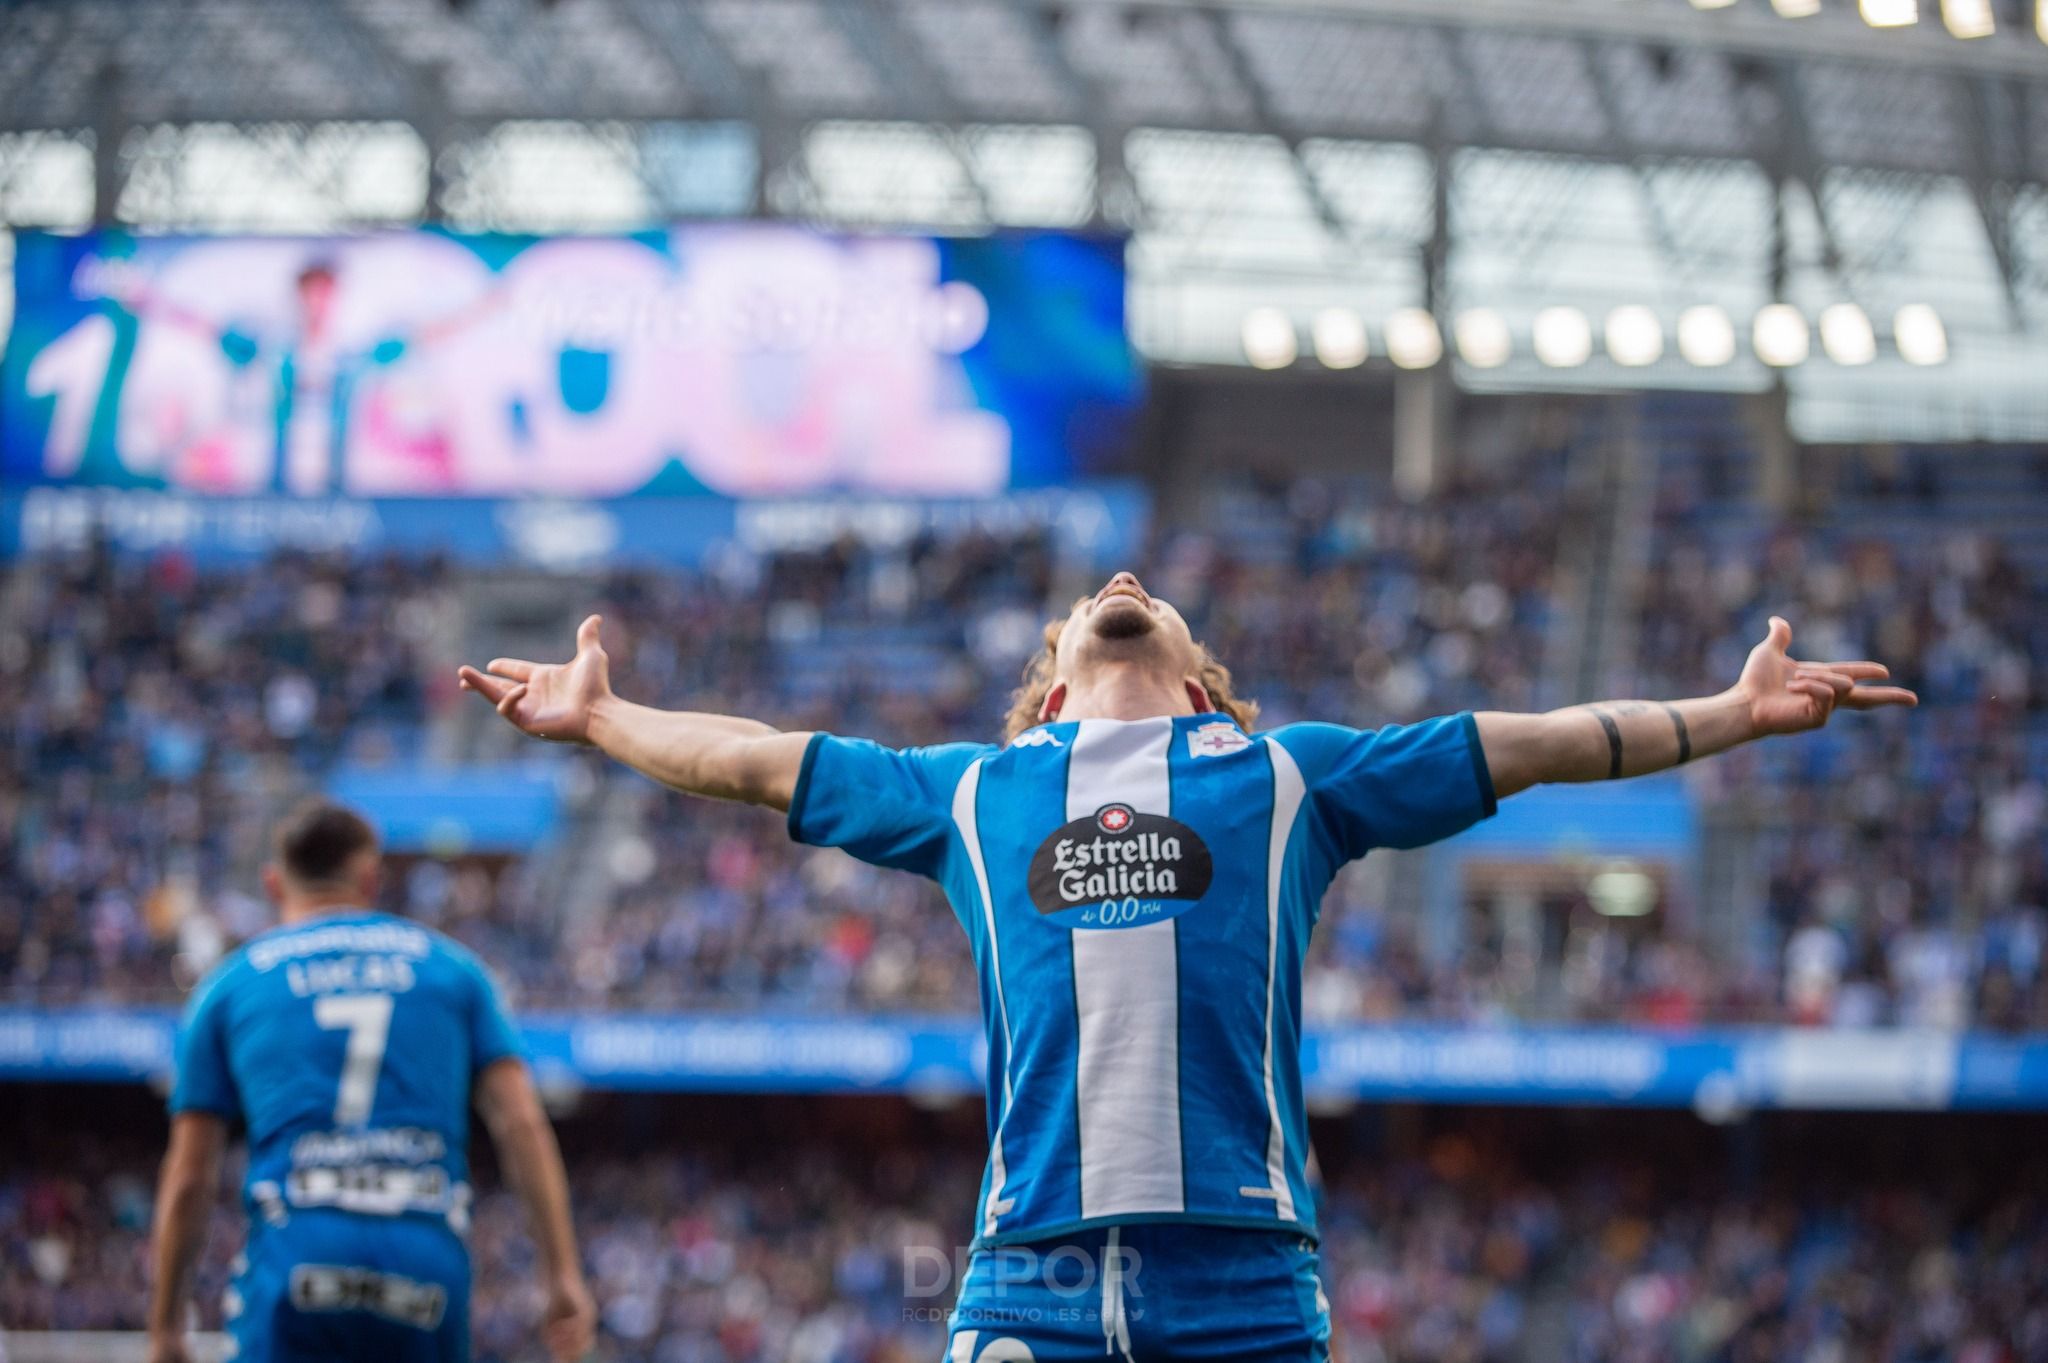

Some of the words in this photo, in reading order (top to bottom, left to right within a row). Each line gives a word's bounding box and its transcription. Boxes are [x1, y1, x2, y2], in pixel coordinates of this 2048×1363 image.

[1053, 832, 1182, 872] Estrella
[1059, 863, 1178, 902] Galicia
[1099, 896, 1139, 925] 0,0
[286, 955, 416, 998] LUCAS
[312, 993, 394, 1126] 7
